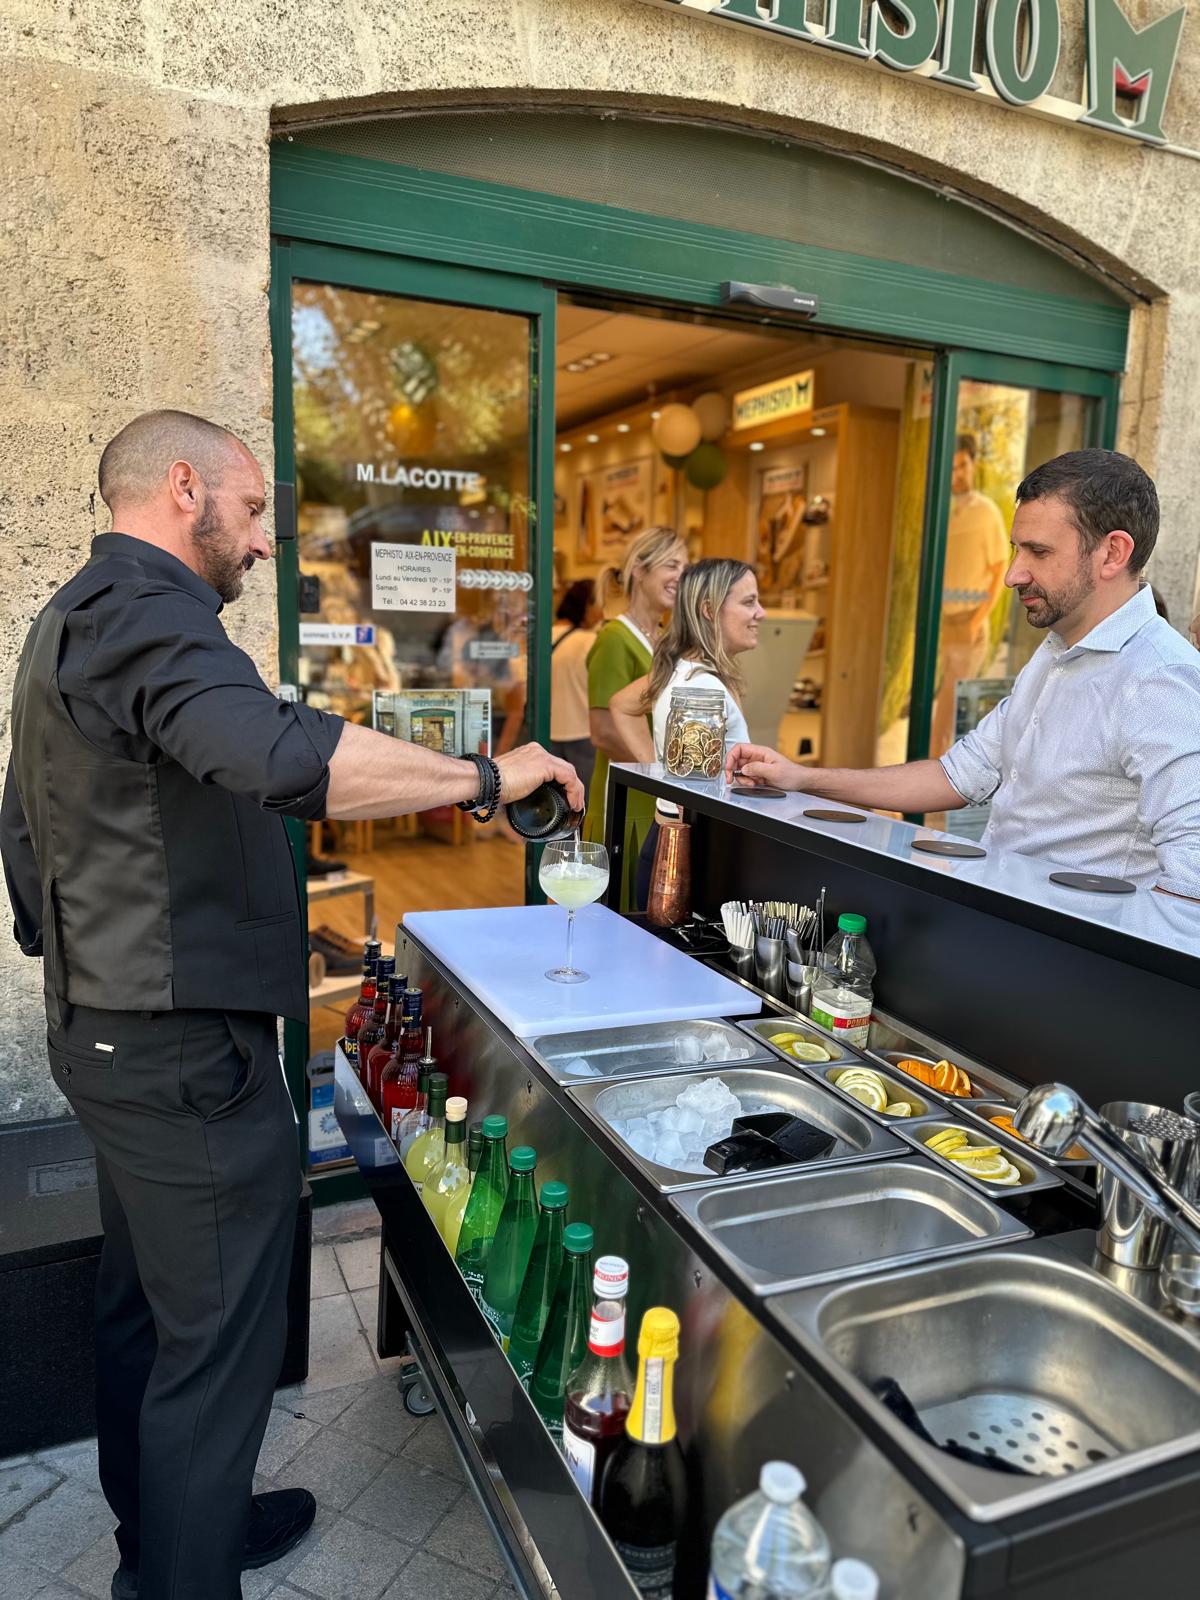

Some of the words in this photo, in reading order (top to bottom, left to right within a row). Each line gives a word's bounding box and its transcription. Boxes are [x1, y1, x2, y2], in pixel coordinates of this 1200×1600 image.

[375, 548, 403, 560] MEPHISTO
[404, 550, 453, 563] AIX-EN-PROVENCE
[397, 564, 432, 573] HORAIRES
[402, 575, 428, 583] Vendredi
[375, 584, 399, 592] Samedi
[428, 599, 437, 607] 23
